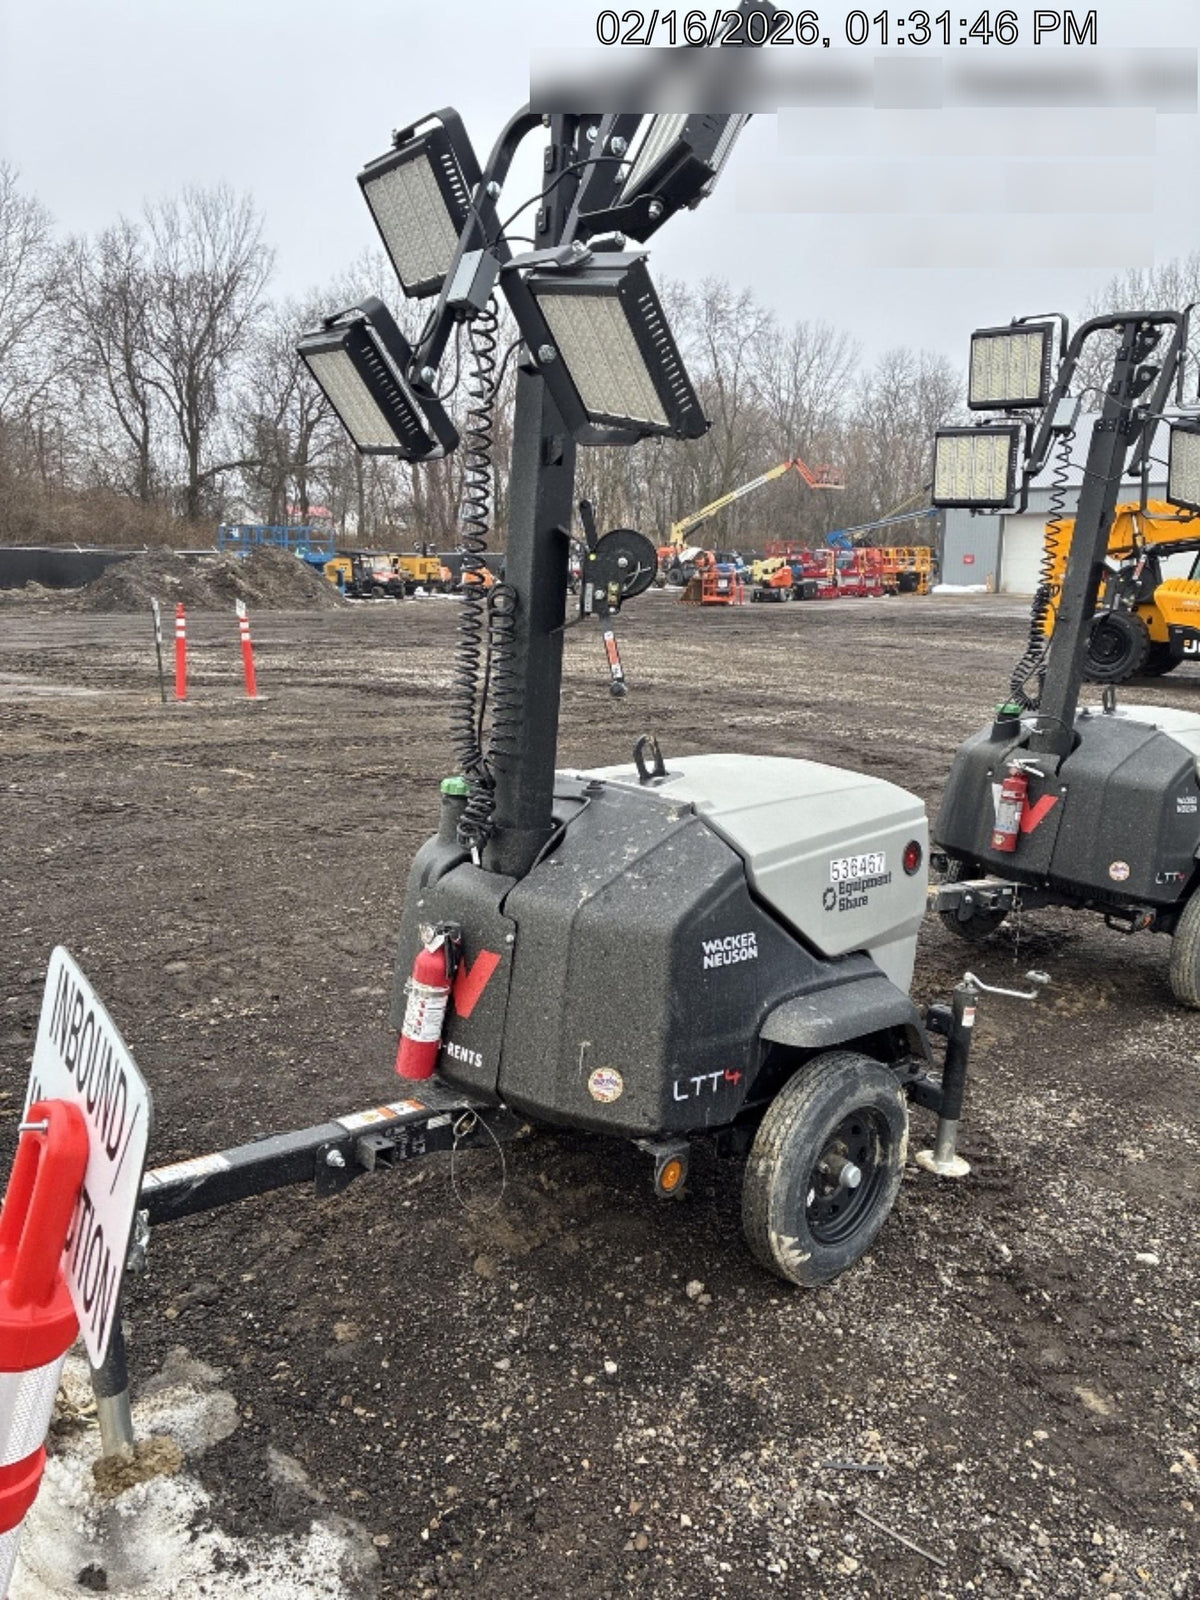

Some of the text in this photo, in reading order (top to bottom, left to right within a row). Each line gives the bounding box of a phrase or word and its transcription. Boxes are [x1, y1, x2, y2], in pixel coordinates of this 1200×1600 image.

[1183, 639, 1200, 653] J
[831, 853, 884, 881] 536467
[838, 871, 892, 896] Equipment
[838, 895, 869, 912] Share
[701, 932, 757, 956] WACKER
[703, 946, 759, 970] NEUSON
[438, 1039, 484, 1068] -RENTS
[673, 1069, 741, 1101] LTT4
